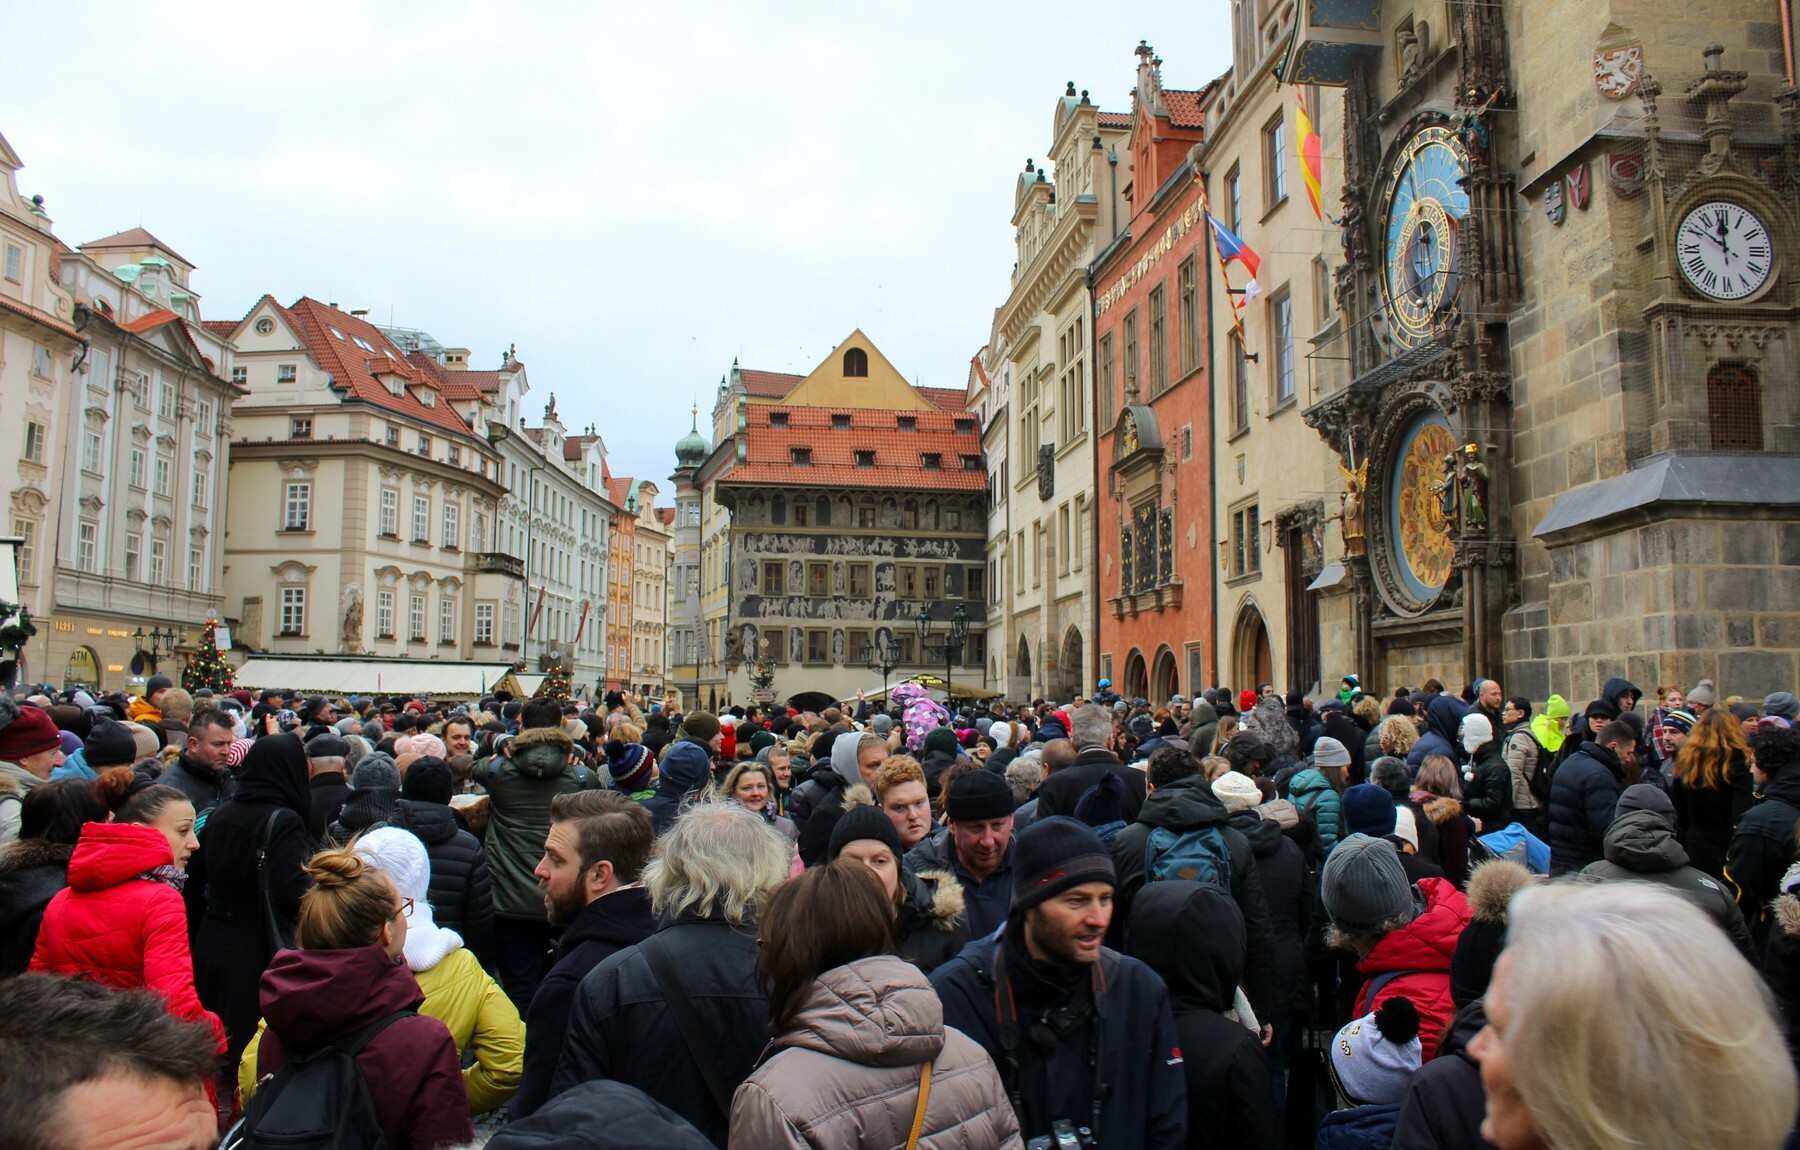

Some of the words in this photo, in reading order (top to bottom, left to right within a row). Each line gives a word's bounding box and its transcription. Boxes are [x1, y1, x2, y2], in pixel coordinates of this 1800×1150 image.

[1698, 212, 1713, 230] XI
[1734, 216, 1744, 229] I
[1744, 228, 1759, 241] II
[1748, 246, 1765, 257] III
[1739, 274, 1750, 288] V
[70, 651, 88, 662] ATM
